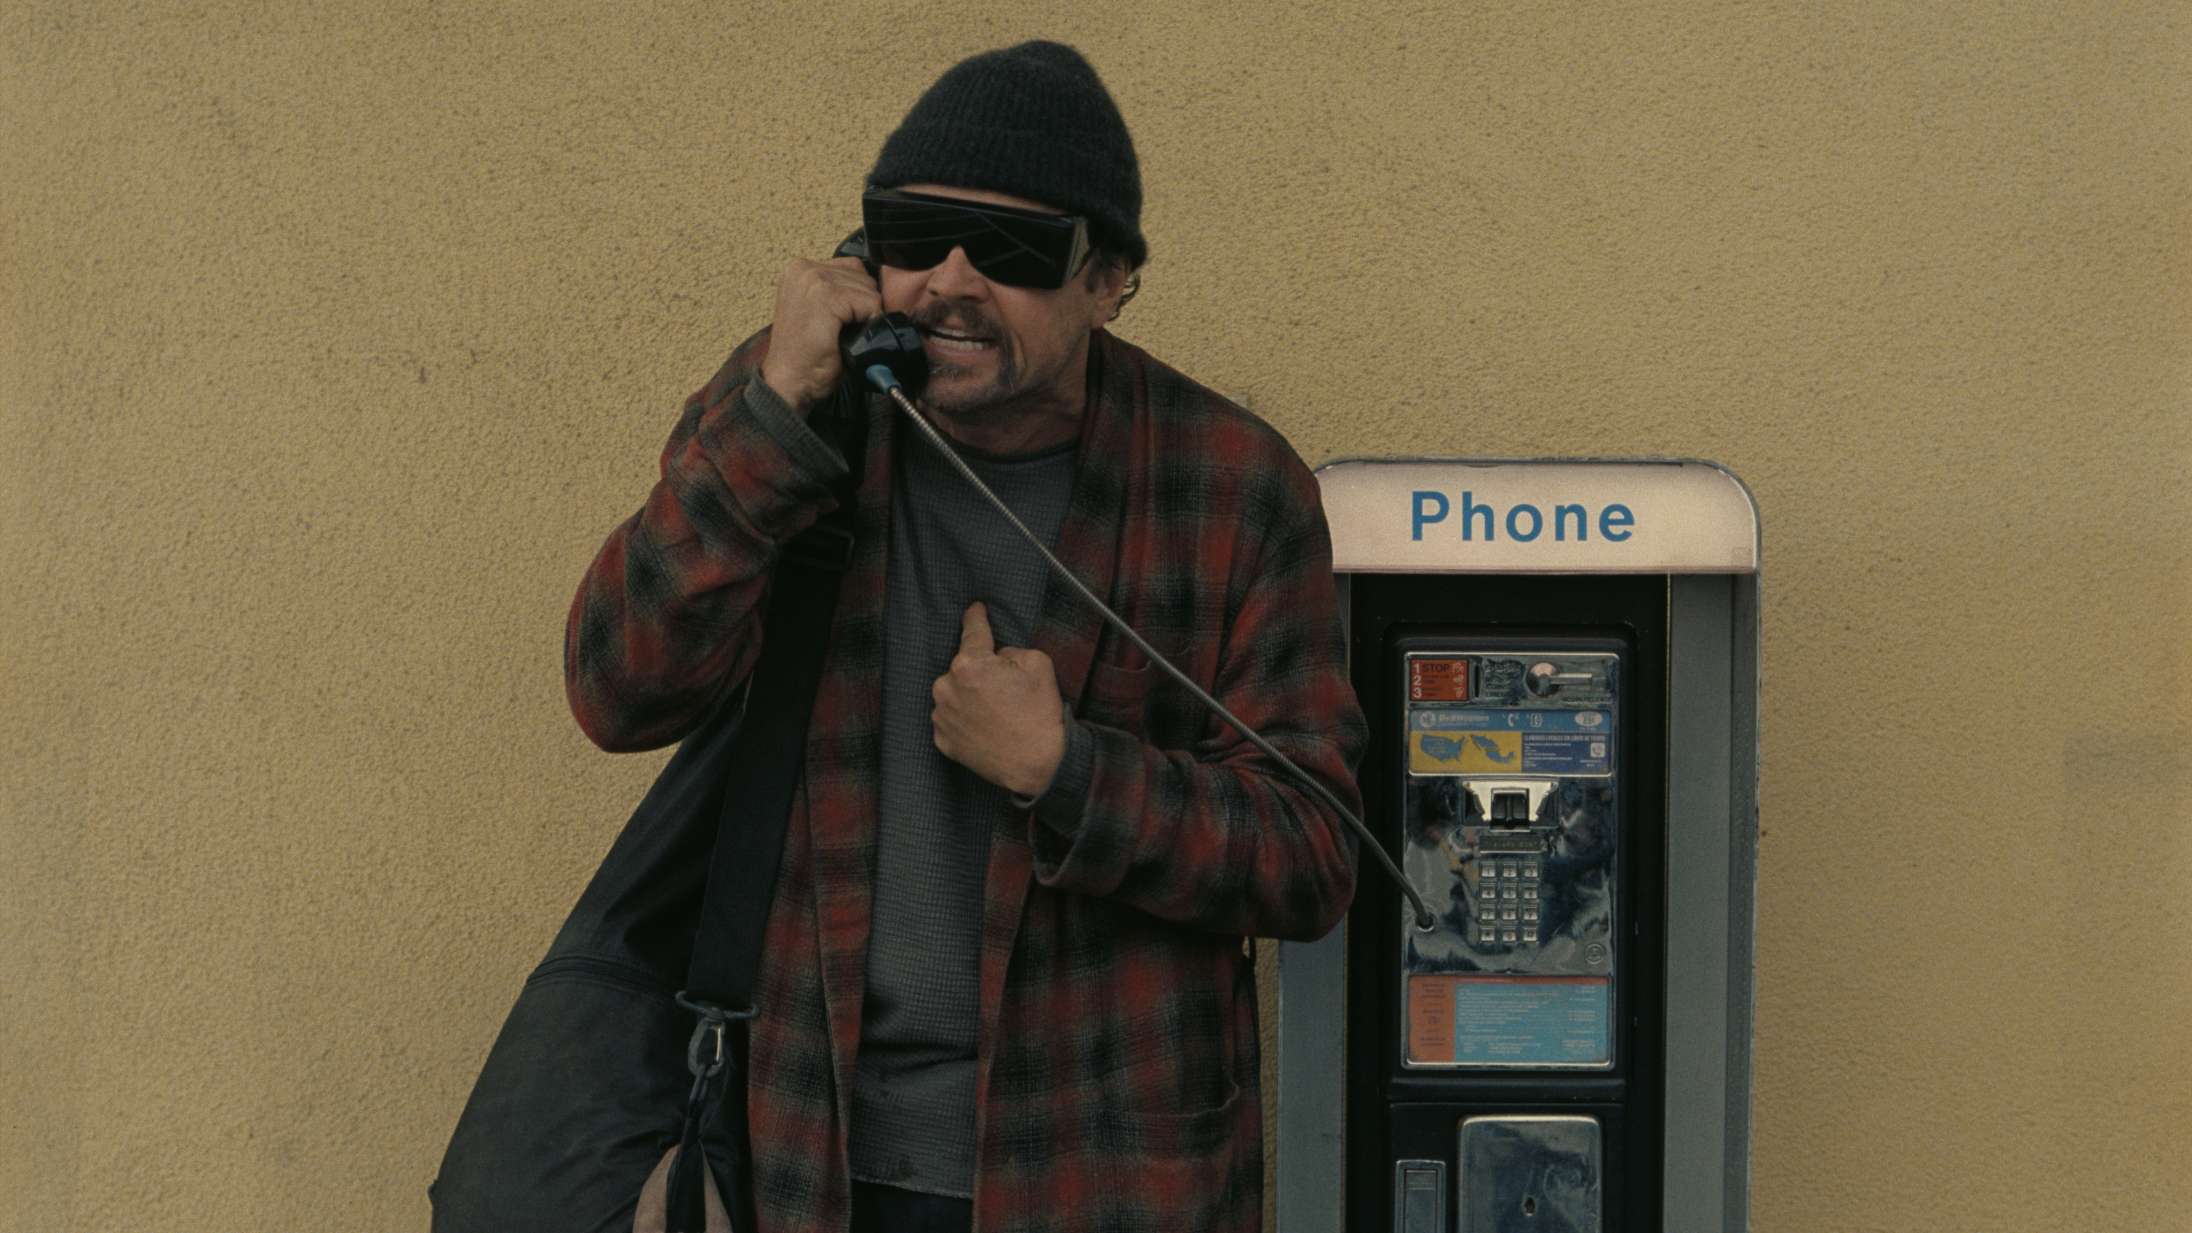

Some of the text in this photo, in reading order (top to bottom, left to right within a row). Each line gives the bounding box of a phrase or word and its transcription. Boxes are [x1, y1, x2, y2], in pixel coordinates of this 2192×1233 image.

[1411, 490, 1635, 543] Phone
[1414, 663, 1450, 674] 1 STOP
[1414, 675, 1422, 686] 2
[1414, 687, 1422, 698] 3
